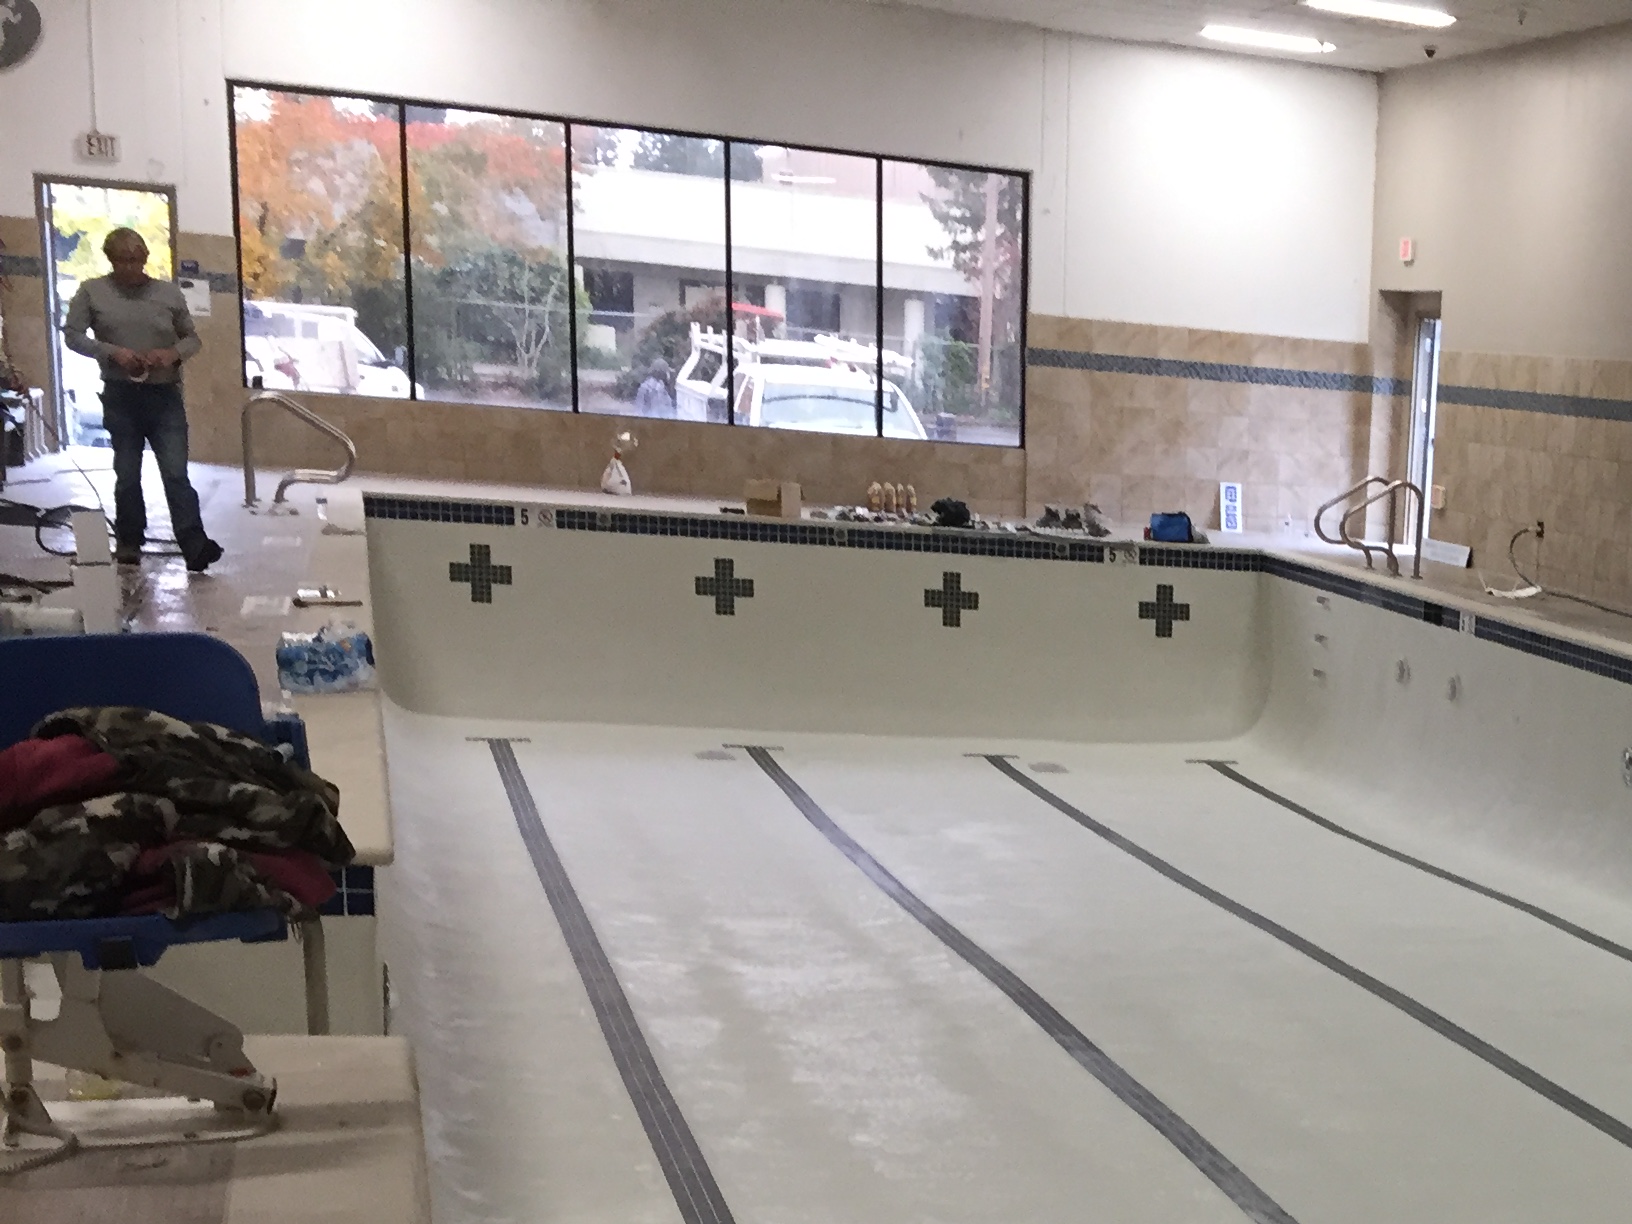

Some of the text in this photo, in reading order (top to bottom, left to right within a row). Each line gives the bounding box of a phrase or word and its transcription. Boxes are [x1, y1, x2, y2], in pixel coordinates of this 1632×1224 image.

[86, 133, 116, 157] EXIT
[521, 508, 529, 525] 5
[1109, 546, 1117, 563] 5
